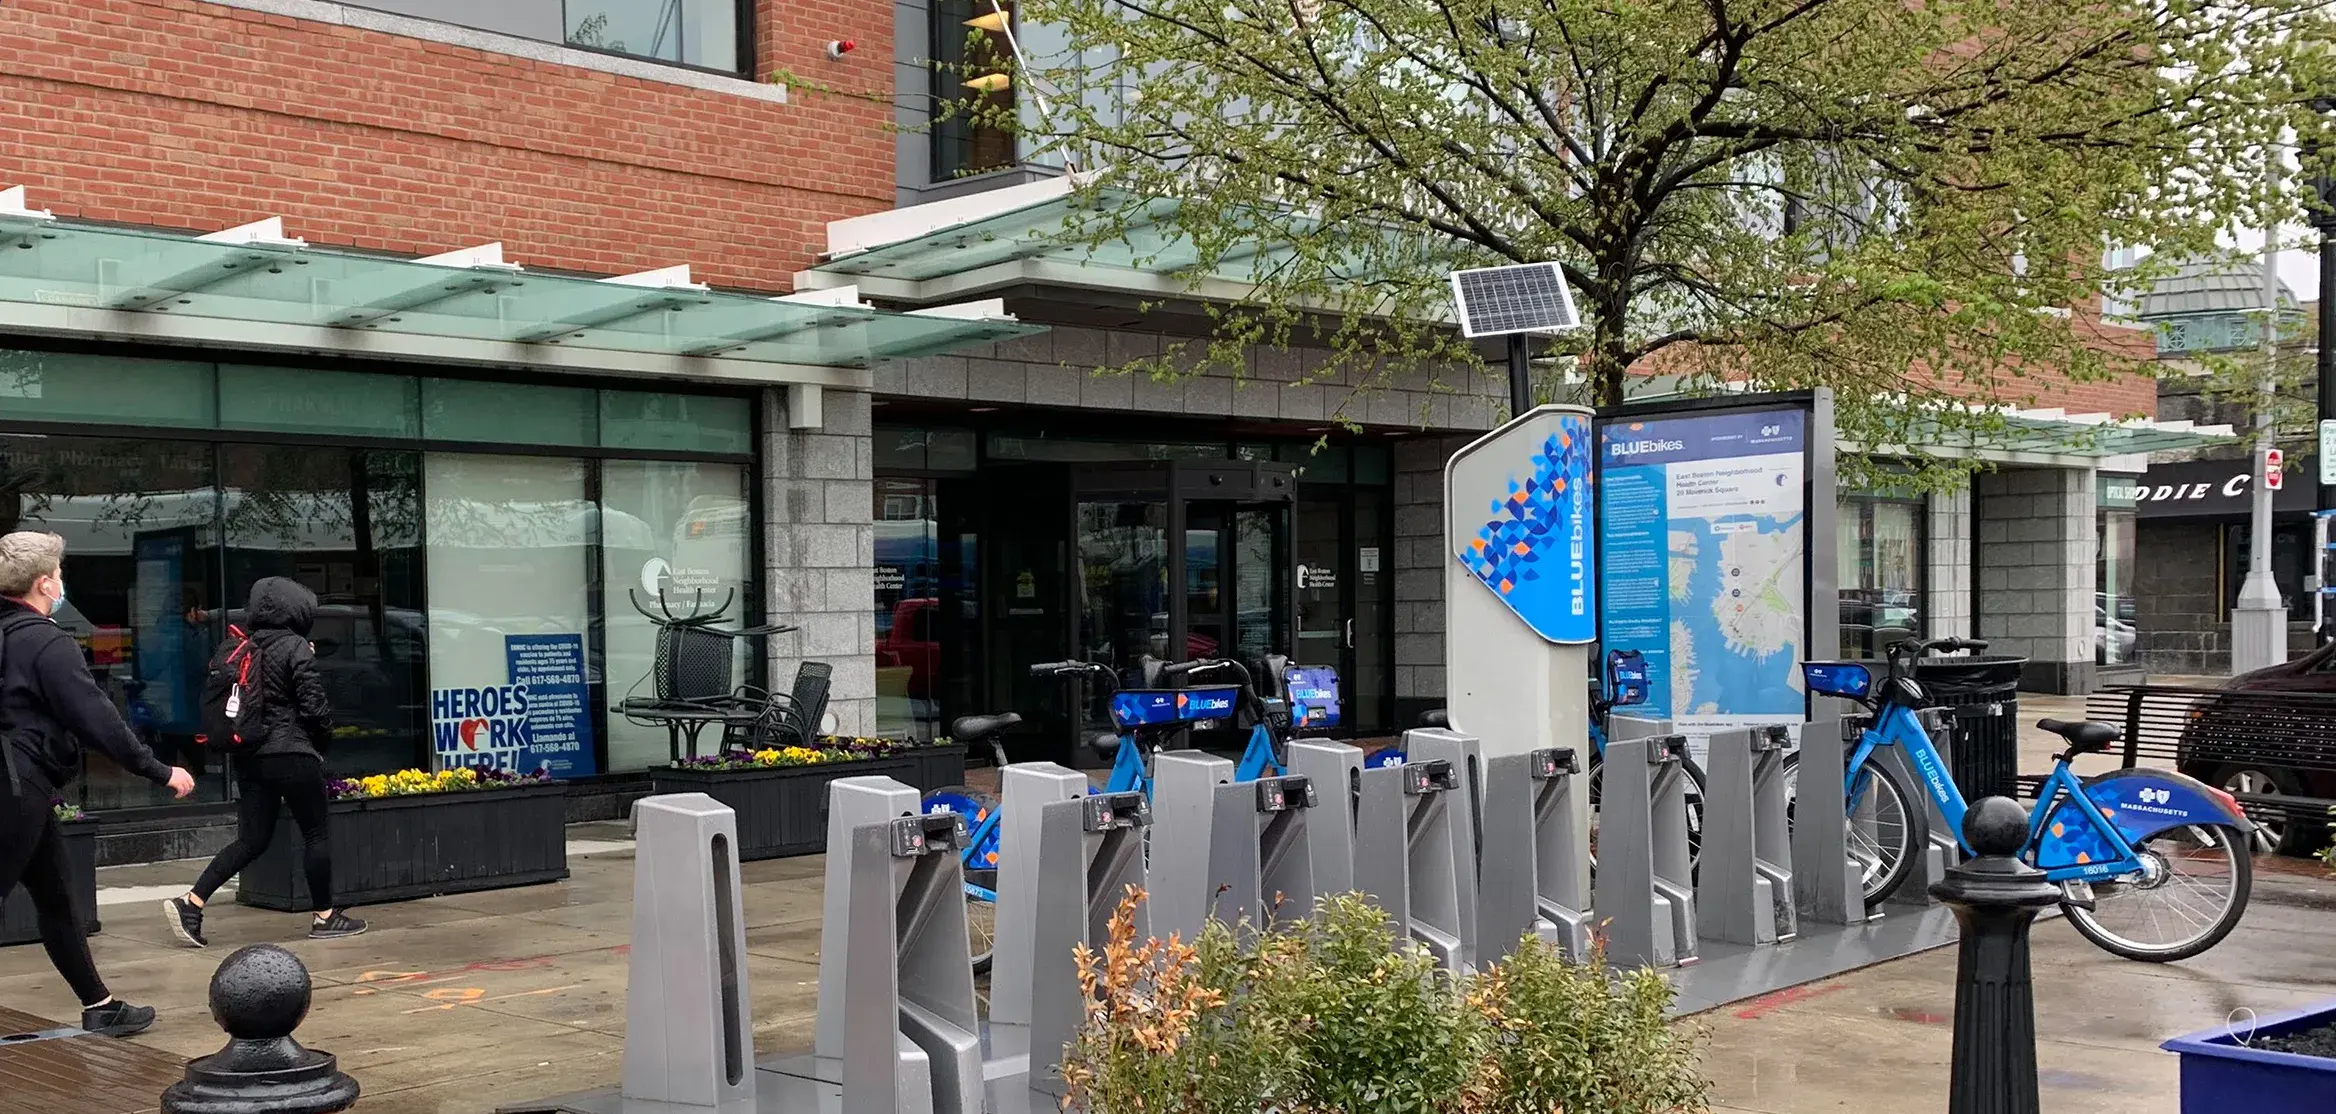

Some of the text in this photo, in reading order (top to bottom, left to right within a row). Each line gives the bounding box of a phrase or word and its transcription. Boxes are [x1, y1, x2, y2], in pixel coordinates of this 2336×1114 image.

[1612, 440, 1683, 456] BLUEbikes
[1716, 467, 1763, 477] Neighborhood
[1697, 479, 1719, 487] Center
[1715, 486, 1738, 494] Square
[1570, 476, 1584, 616] BLUEbikes
[673, 577, 718, 587] Neighborhood
[649, 600, 681, 609] Phamacy
[516, 674, 580, 685] Call 617-568-4870
[1296, 688, 1332, 699] BLUEbikes
[433, 686, 528, 719] HEROES
[1189, 699, 1229, 710] BLUEbikes
[532, 732, 575, 743] Llamando al
[530, 742, 579, 753] 617-568-4870
[1916, 748, 1949, 802] BLUEbikes
[2120, 803, 2188, 817] MASSACHUSETTS
[2083, 864, 2109, 875] 16016
